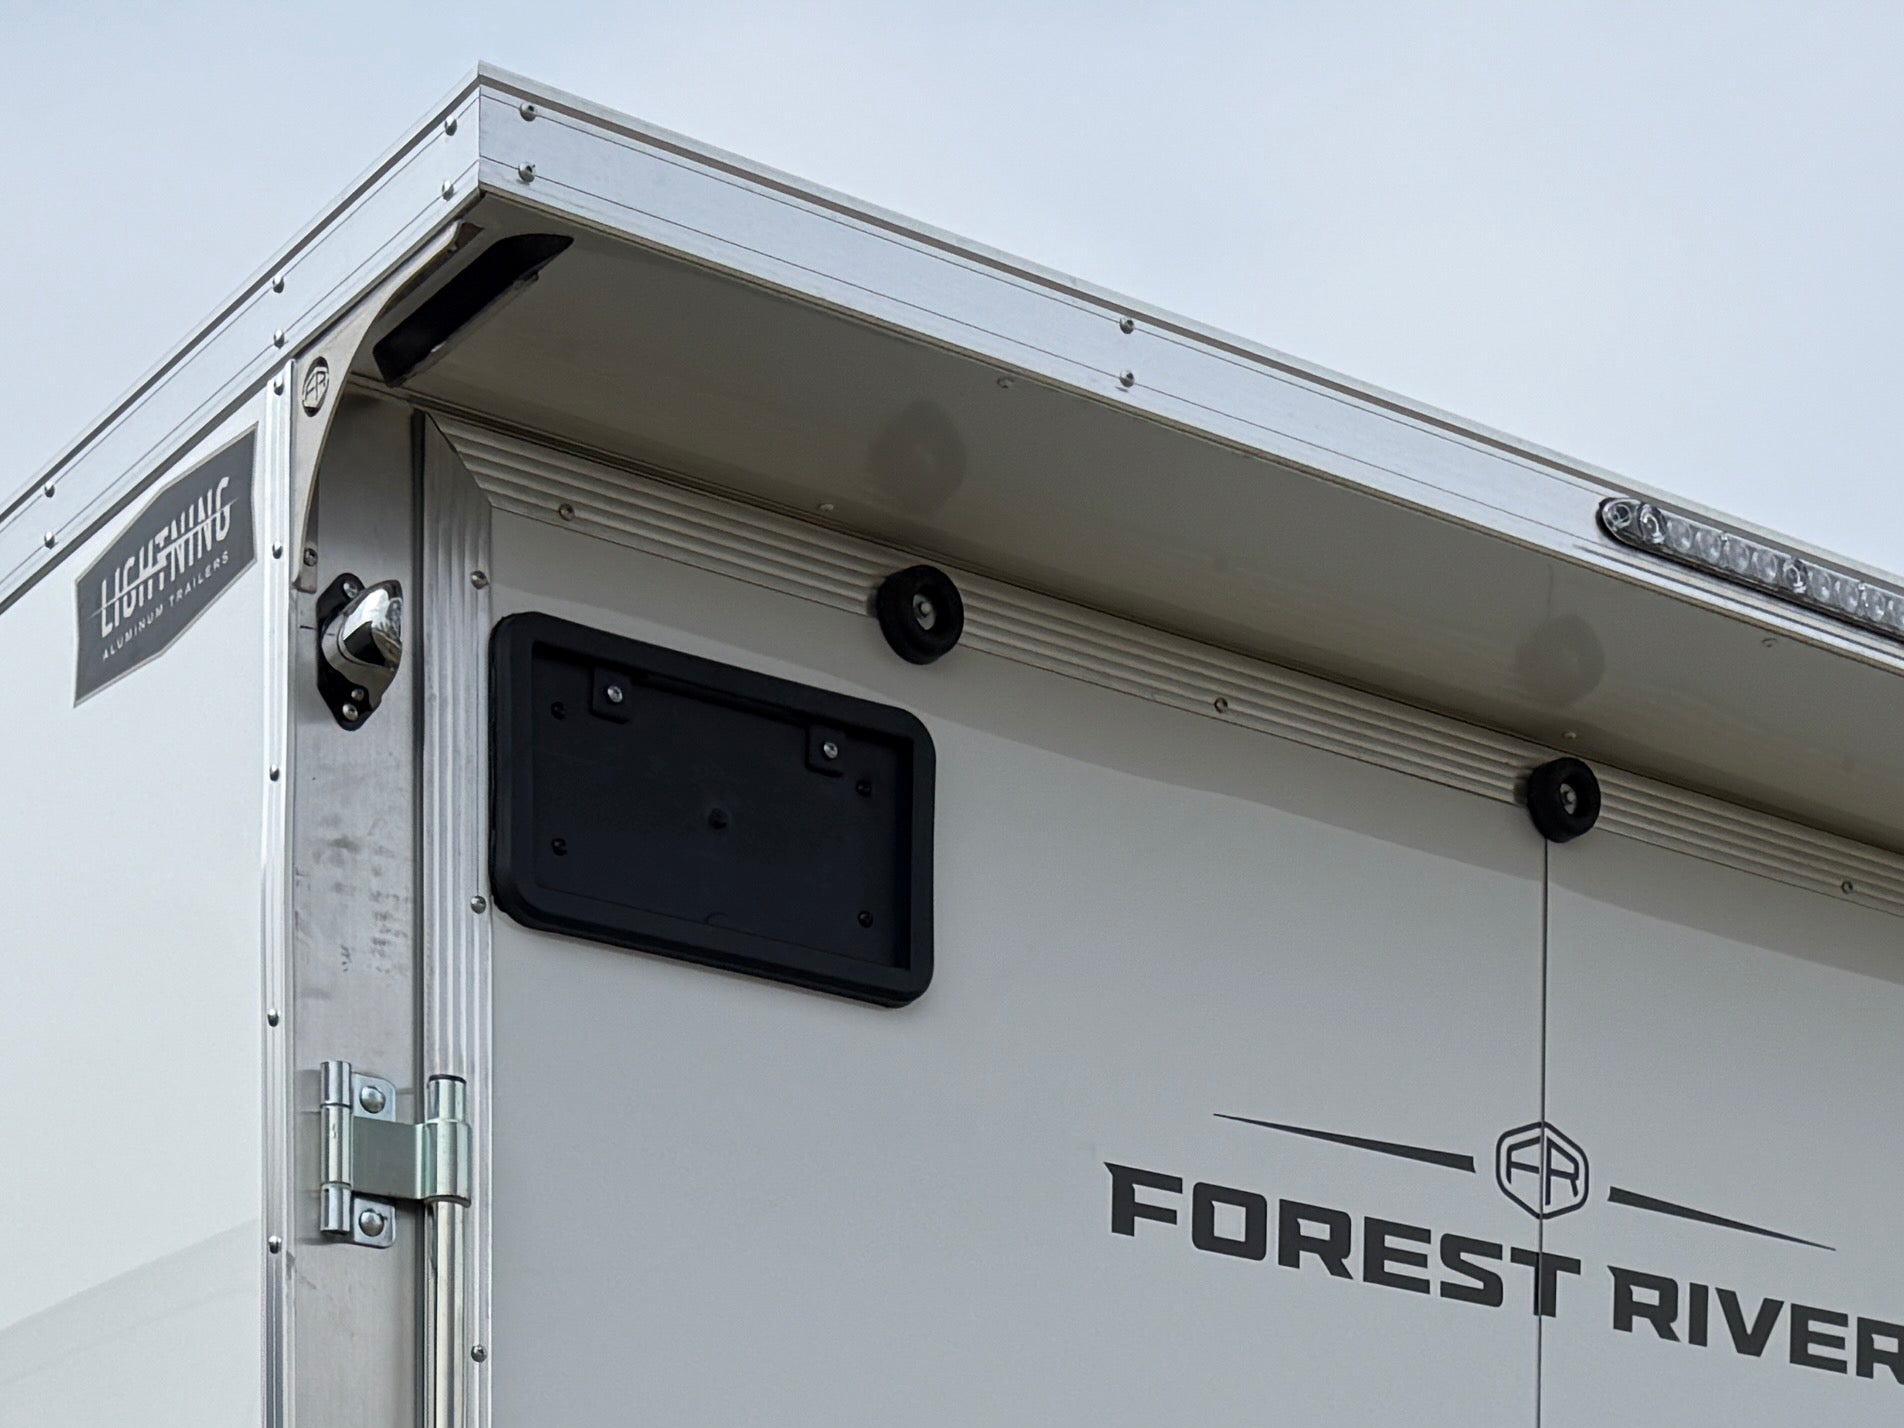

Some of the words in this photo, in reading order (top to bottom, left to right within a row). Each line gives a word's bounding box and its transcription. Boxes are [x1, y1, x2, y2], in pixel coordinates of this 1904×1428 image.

[100, 476, 231, 639] LIGHTNING
[102, 606, 163, 661] ALUMINUM
[169, 550, 230, 607] TRAILERS
[1103, 1161, 1582, 1318] FOREST
